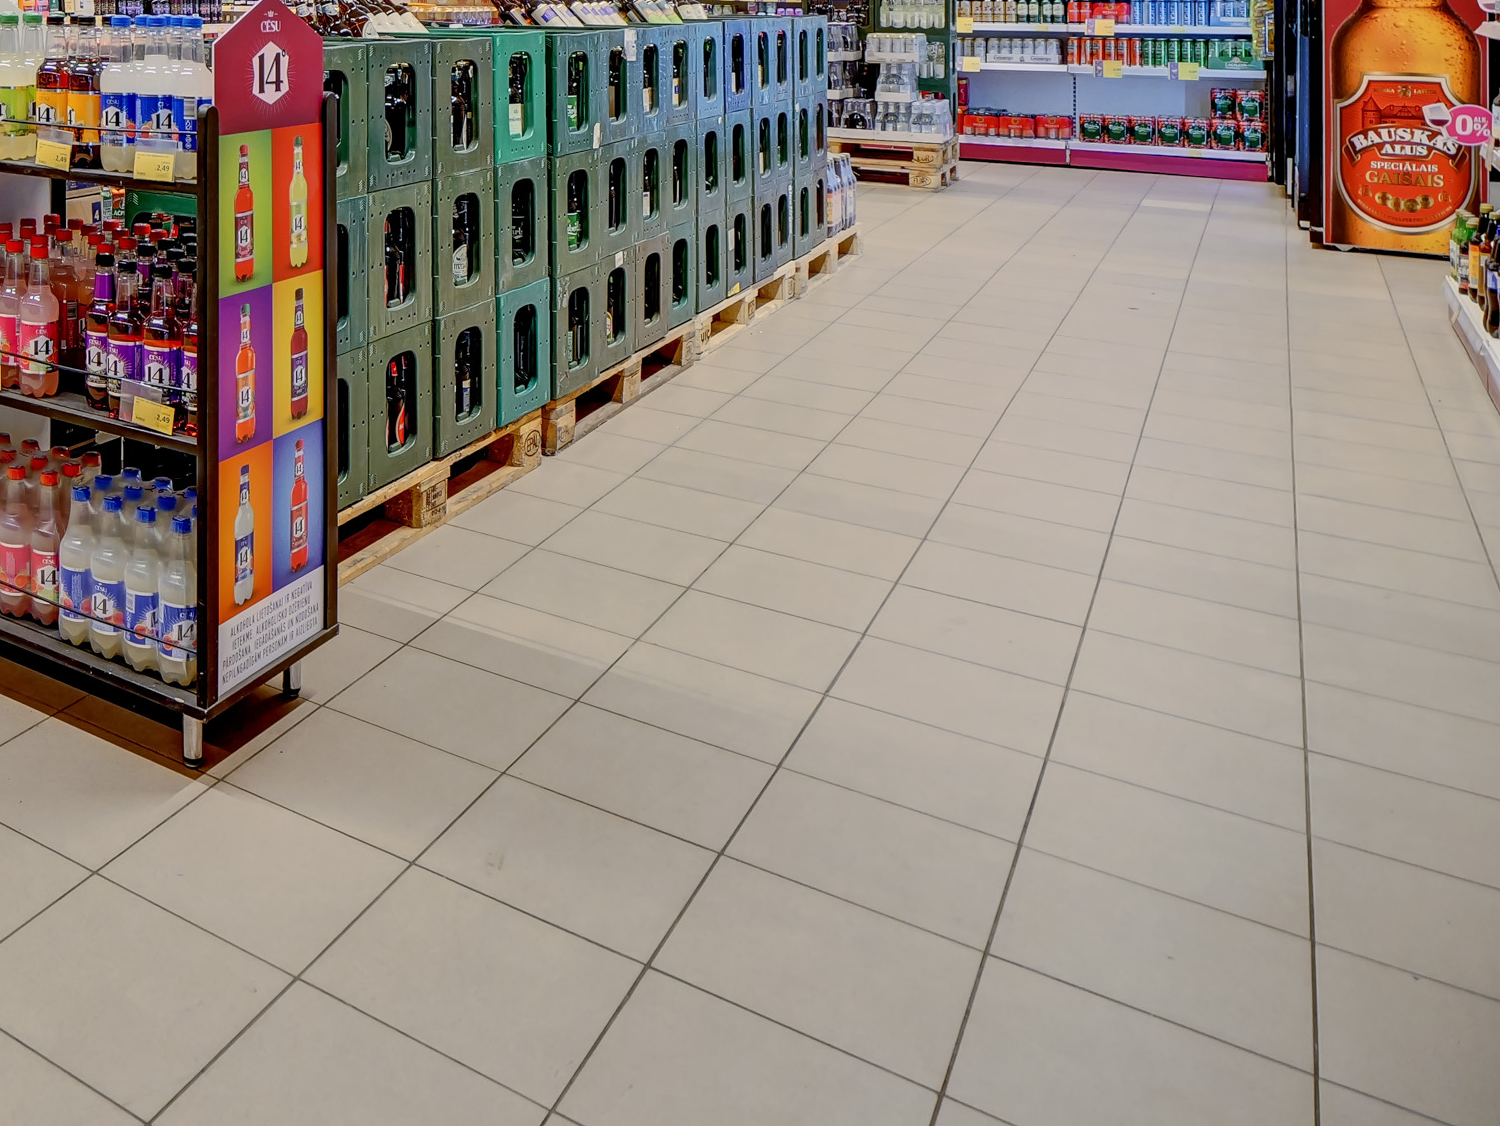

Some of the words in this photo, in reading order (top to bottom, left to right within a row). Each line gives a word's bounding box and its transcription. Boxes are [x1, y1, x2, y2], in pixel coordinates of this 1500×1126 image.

[105, 111, 121, 127] 14
[156, 113, 172, 129] 14
[1455, 114, 1491, 137] 0%
[1351, 127, 1459, 155] BAUSKAS
[1381, 144, 1428, 157] ALUS
[55, 155, 67, 163] 2,49
[1370, 161, 1438, 173] SPECIĀLAIS
[156, 164, 170, 172] 2,49
[1365, 170, 1444, 188] GAIŠAIS
[295, 215, 303, 230] 14
[240, 228, 248, 243] 14
[34, 340, 51, 355] 14
[88, 350, 103, 366] 14
[147, 366, 164, 384] 14
[240, 390, 250, 405] 14
[156, 414, 170, 423] 2,49
[526, 433, 538, 455] EPAL
[294, 518, 304, 534] 14
[239, 551, 249, 567] 14
[41, 569, 57, 585] 14
[93, 595, 109, 614] 14
[230, 615, 255, 637] ALKOHOLA
[256, 600, 284, 622] LIETOŠANAI
[285, 594, 289, 604] IR
[256, 611, 287, 634] ALKOHOLISKO
[287, 619, 294, 630] UN
[295, 602, 319, 624] NODOŠANA
[177, 623, 194, 641] 14
